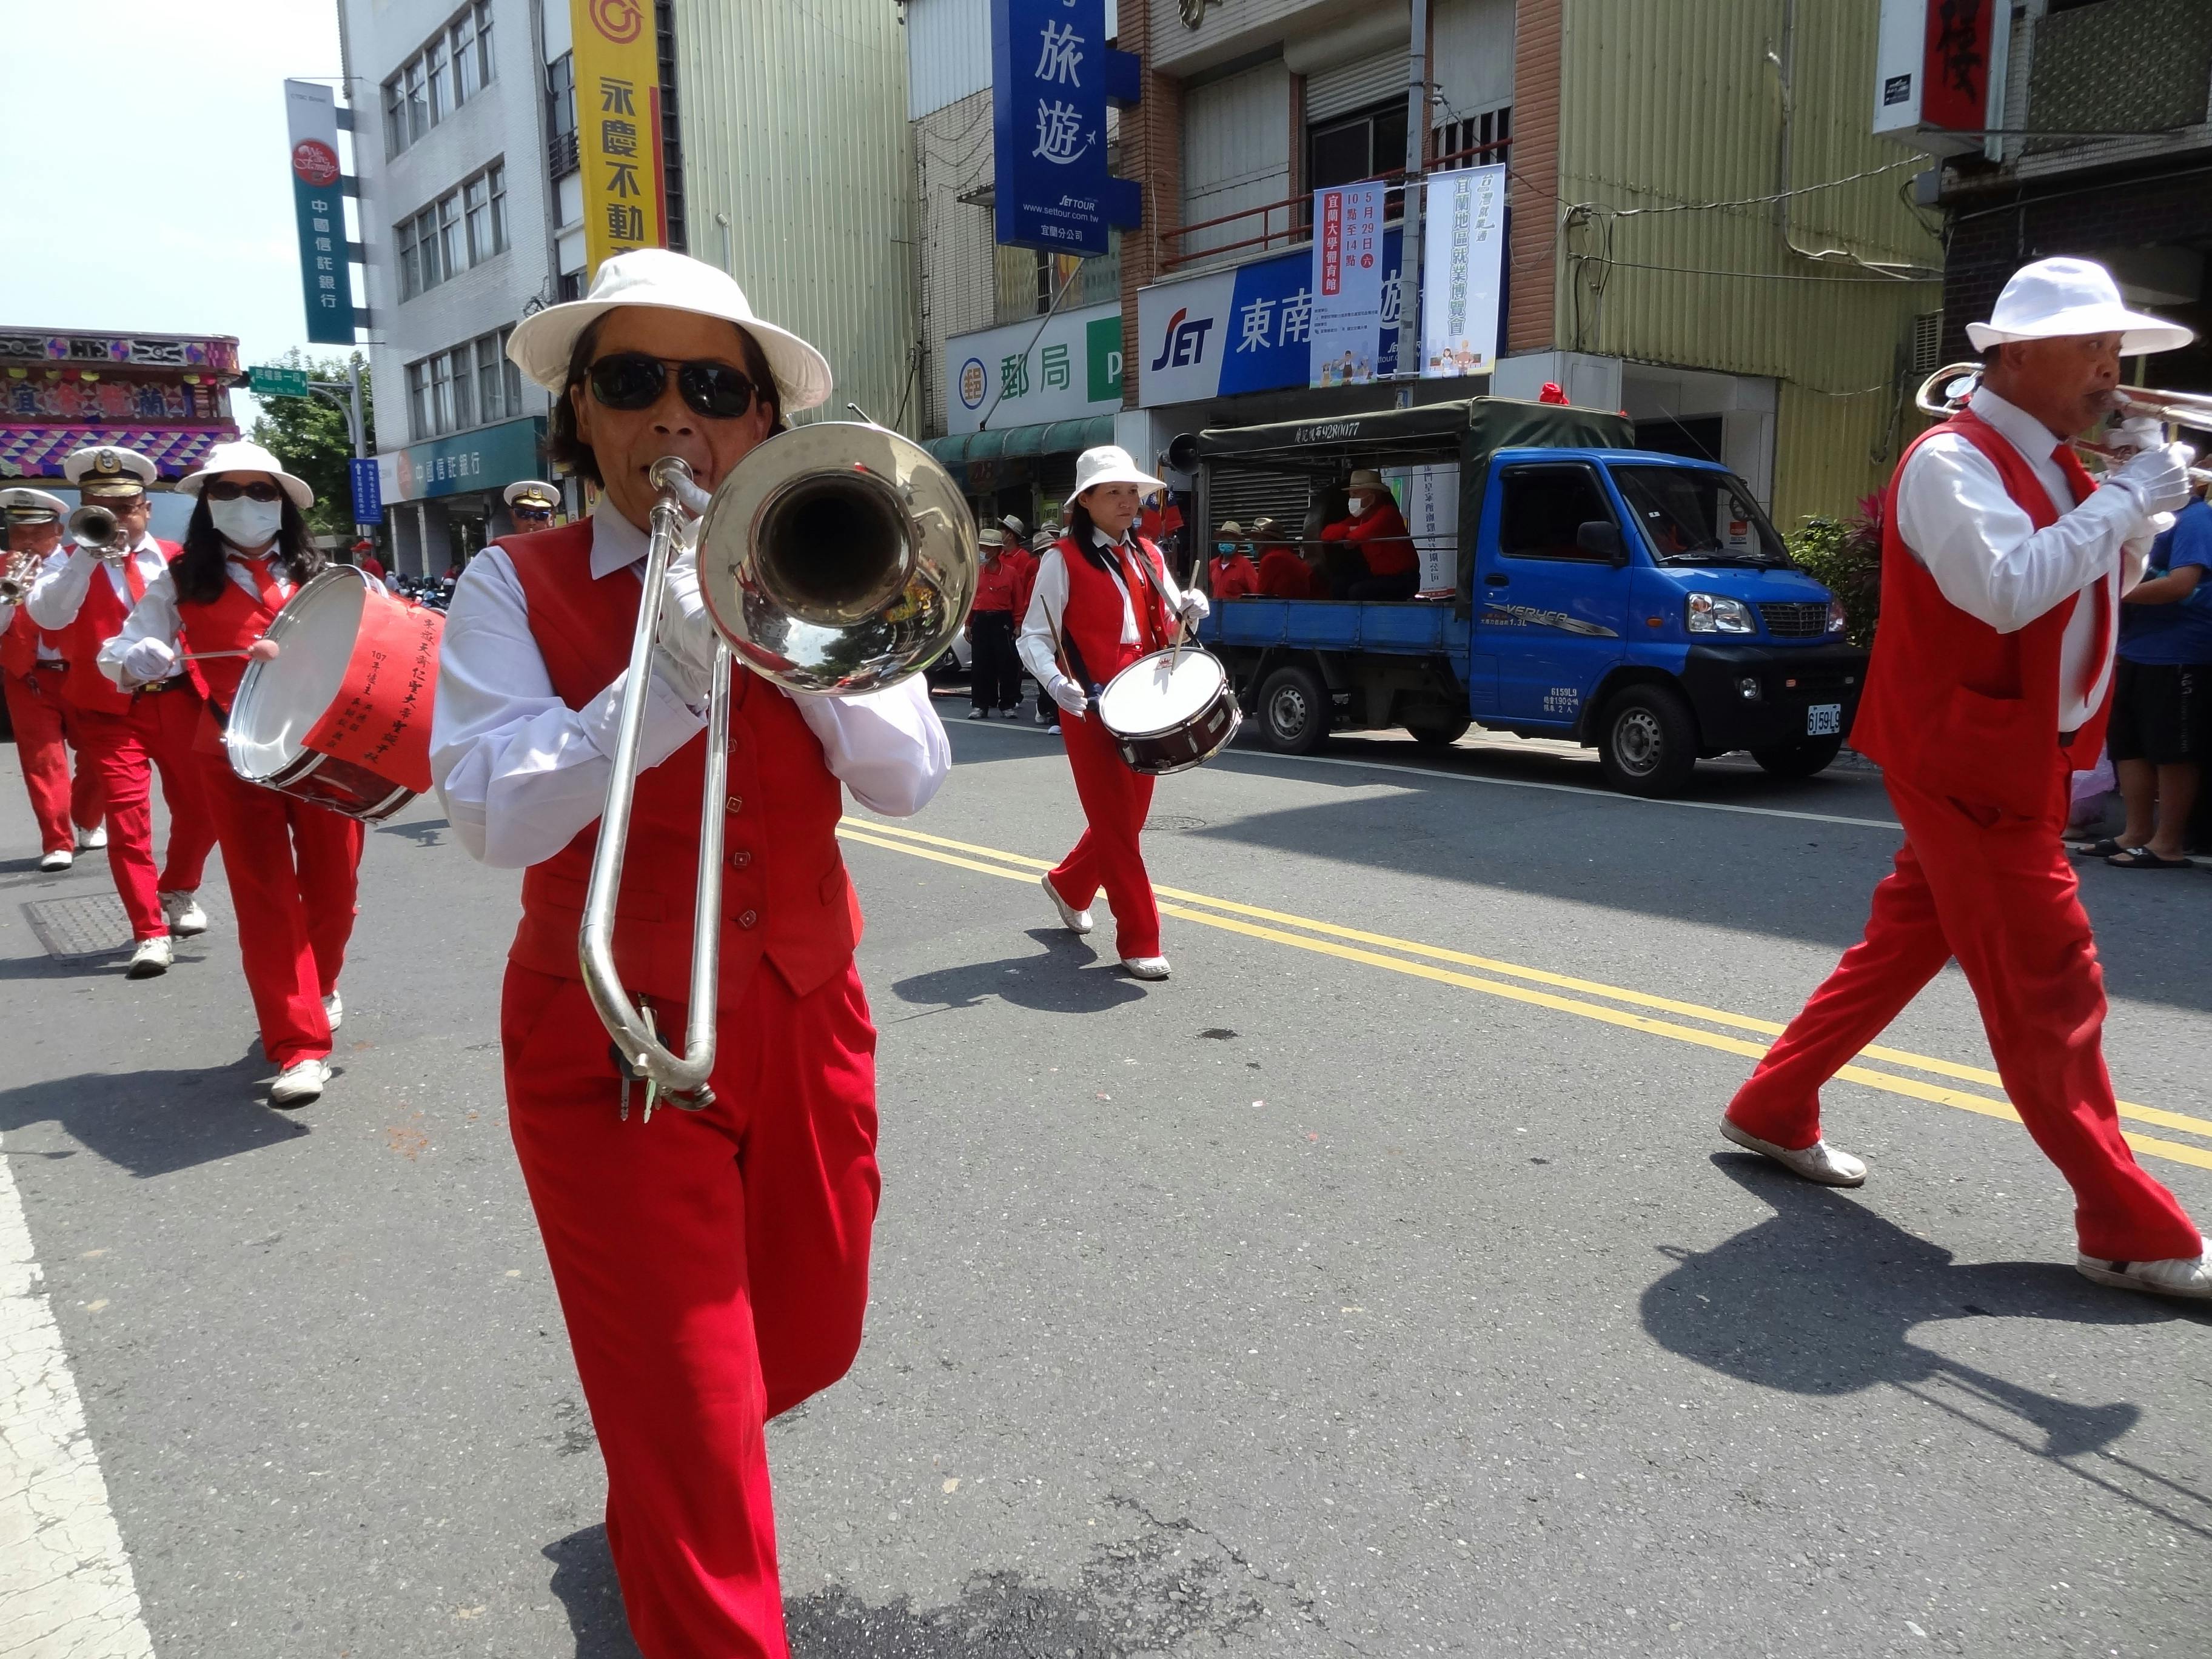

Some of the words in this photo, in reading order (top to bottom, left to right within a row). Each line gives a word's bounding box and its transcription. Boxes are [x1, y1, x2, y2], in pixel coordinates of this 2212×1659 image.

[1033, 0, 1087, 164] 旅遊
[600, 76, 644, 260] 永慶不動
[311, 199, 337, 308] 中國信託銀行
[1041, 224, 1082, 241] 宜蘭分公司
[1326, 195, 1339, 291] 宜蘭大學體育館
[1346, 193, 1359, 267] 10點至14點
[1449, 175, 1472, 336] 宜蘭地區就業博覽會
[1000, 344, 1070, 401] 郵局
[415, 452, 480, 483] 中國信託銀行
[1507, 604, 1567, 623] VERYCA
[1551, 688, 1577, 697] 6159L9
